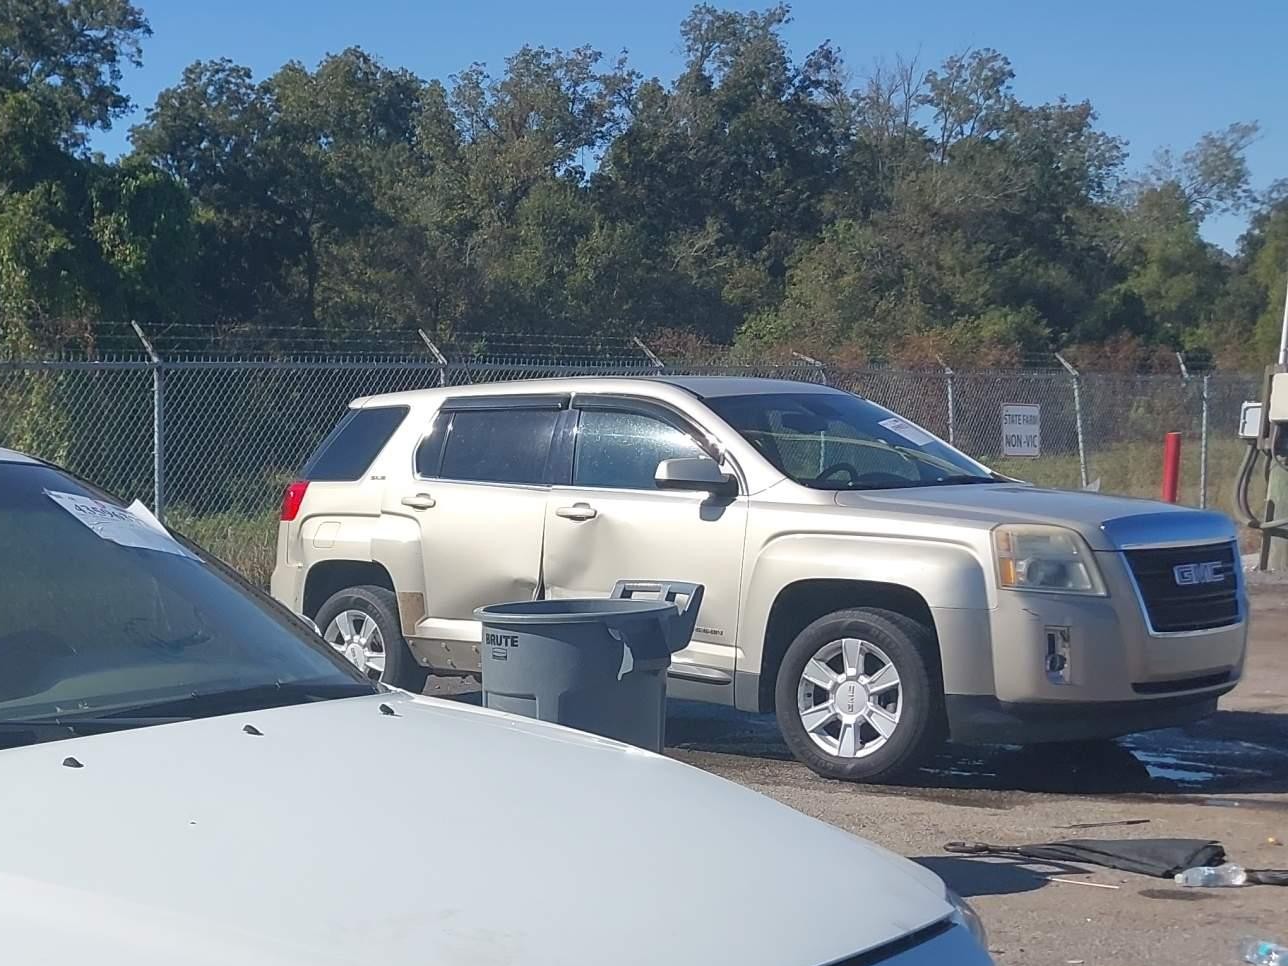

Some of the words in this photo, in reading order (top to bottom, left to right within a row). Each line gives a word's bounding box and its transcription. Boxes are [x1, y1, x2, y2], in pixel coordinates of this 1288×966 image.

[1005, 434, 1038, 448] NON-VIC
[1173, 561, 1224, 585] GMC
[486, 633, 519, 647] BRUTE
